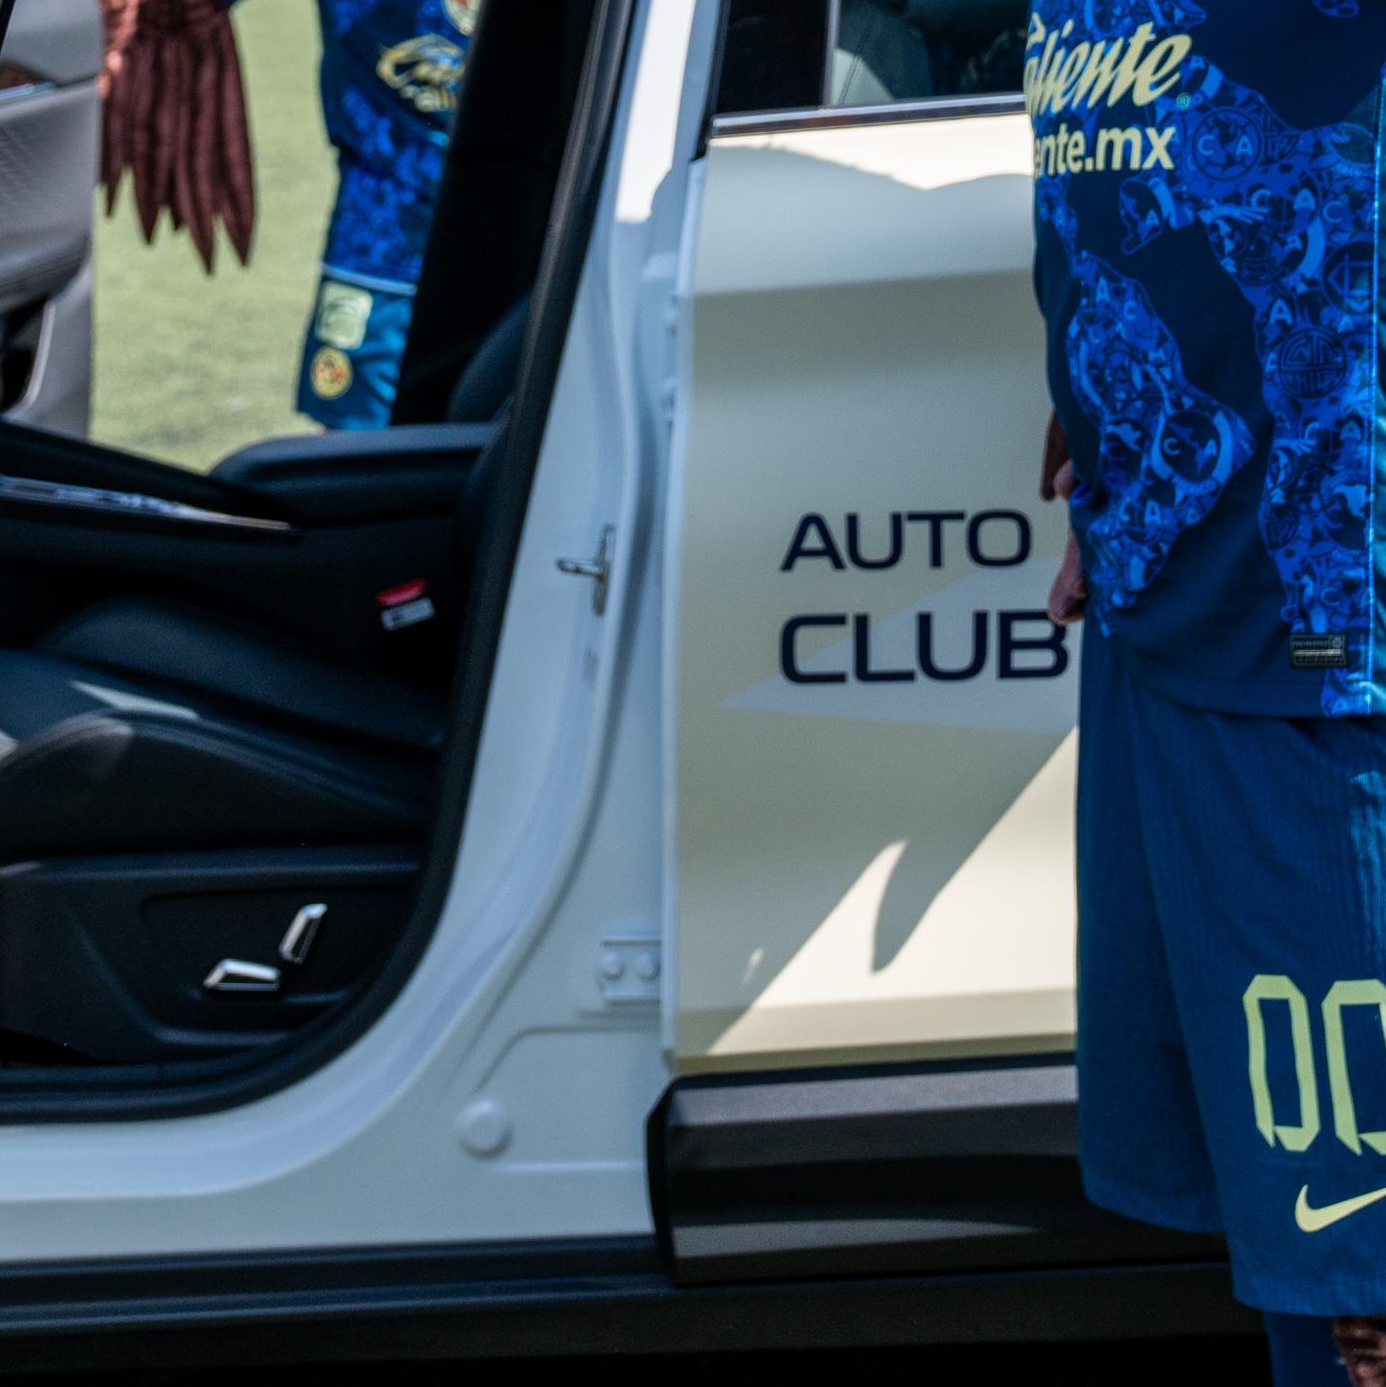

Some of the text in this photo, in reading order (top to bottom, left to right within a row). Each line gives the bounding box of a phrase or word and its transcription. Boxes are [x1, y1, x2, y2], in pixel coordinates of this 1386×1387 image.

[1034, 122, 1176, 177] nte.mx
[780, 509, 1032, 572] AUTO
[779, 608, 1070, 684] CLUB
